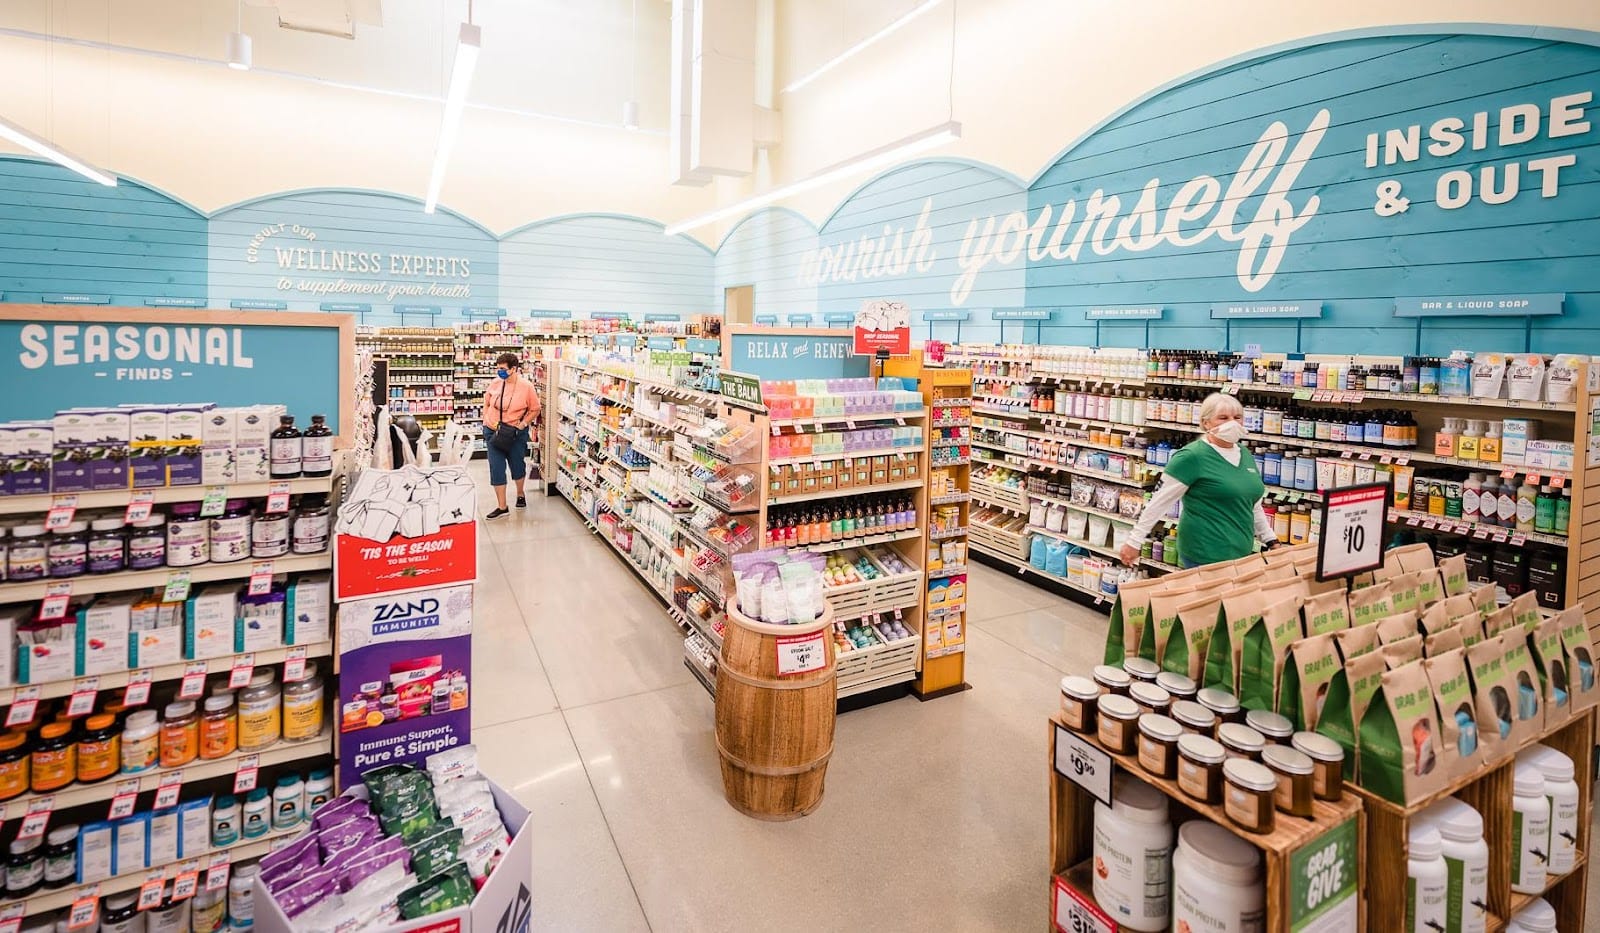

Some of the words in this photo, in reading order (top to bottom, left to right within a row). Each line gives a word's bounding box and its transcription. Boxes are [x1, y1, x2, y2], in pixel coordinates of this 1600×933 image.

[1365, 91, 1593, 169] INSIDE
[1375, 180, 1411, 217] &
[1436, 154, 1577, 210] OUT
[795, 196, 937, 287] nourish
[950, 108, 1331, 305] yourself
[247, 223, 285, 263] CONSULT
[292, 224, 317, 242] OUR
[275, 246, 381, 273] WELLNESS
[389, 253, 471, 278] EXPERTS
[277, 276, 292, 290] to
[297, 278, 385, 295] supplement
[386, 282, 425, 302] your
[427, 283, 472, 298] health
[1458, 301, 1494, 309] LIQUID
[1499, 300, 1529, 308] SOAP
[19, 324, 254, 369] SEASONAL
[747, 341, 788, 359] RELAX
[793, 340, 808, 358] and
[116, 368, 173, 380] FINDS
[723, 381, 736, 396] THE
[737, 383, 758, 402] BALM
[360, 547, 383, 560] 'TIS
[385, 544, 408, 557] THE
[409, 538, 454, 554] SEASON
[1343, 524, 1365, 554] $10
[373, 598, 439, 622] ZAND
[1354, 605, 1370, 618] GRAB
[1373, 601, 1388, 613] GIVE
[374, 616, 438, 633] IMMUNITY
[355, 750, 391, 768] Pure
[394, 745, 406, 758] &
[408, 734, 458, 755] Simple
[360, 735, 407, 752] Immune
[1108, 846, 1133, 865] PROTEIN
[1307, 842, 1337, 879] GRAB
[1307, 859, 1344, 909] GIVE
[1195, 909, 1226, 931] PROTEIN
